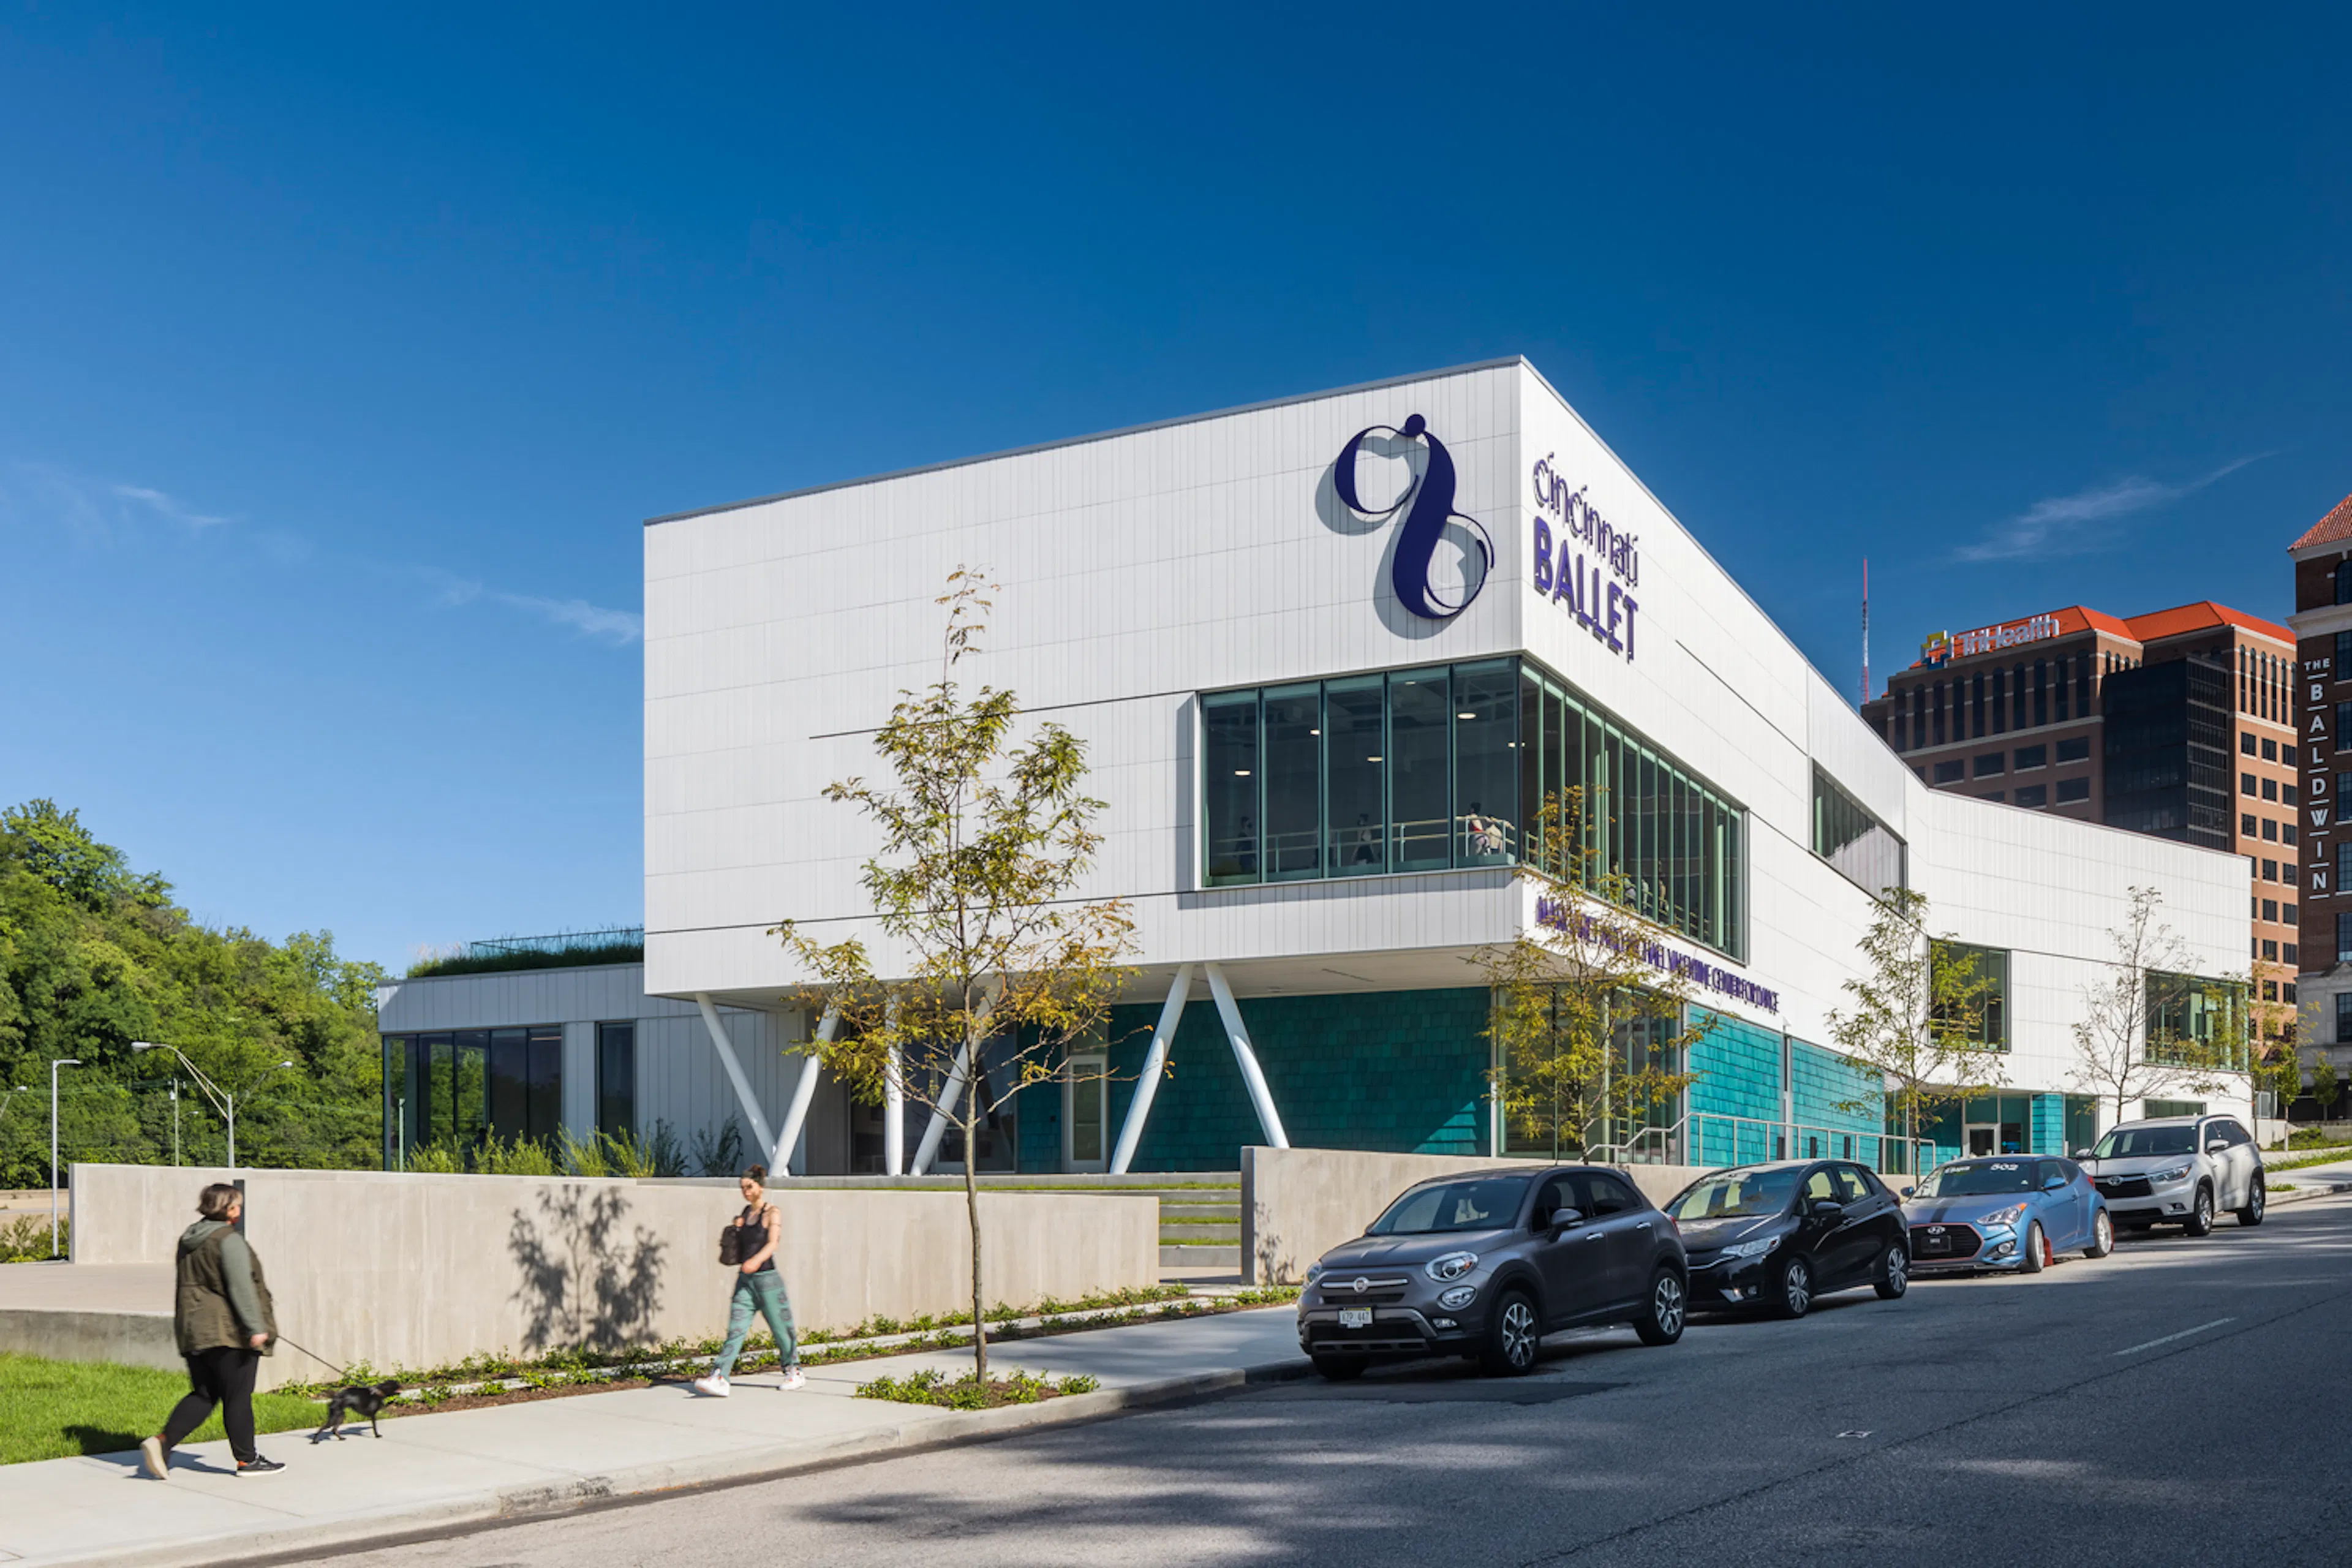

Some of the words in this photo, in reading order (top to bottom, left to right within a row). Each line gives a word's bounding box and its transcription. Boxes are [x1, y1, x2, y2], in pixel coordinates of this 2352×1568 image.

[1533, 516, 1639, 663] BALLET
[1958, 614, 2060, 657] TriHealth
[2304, 658, 2331, 672] THE
[2309, 684, 2329, 890] BALDWIN
